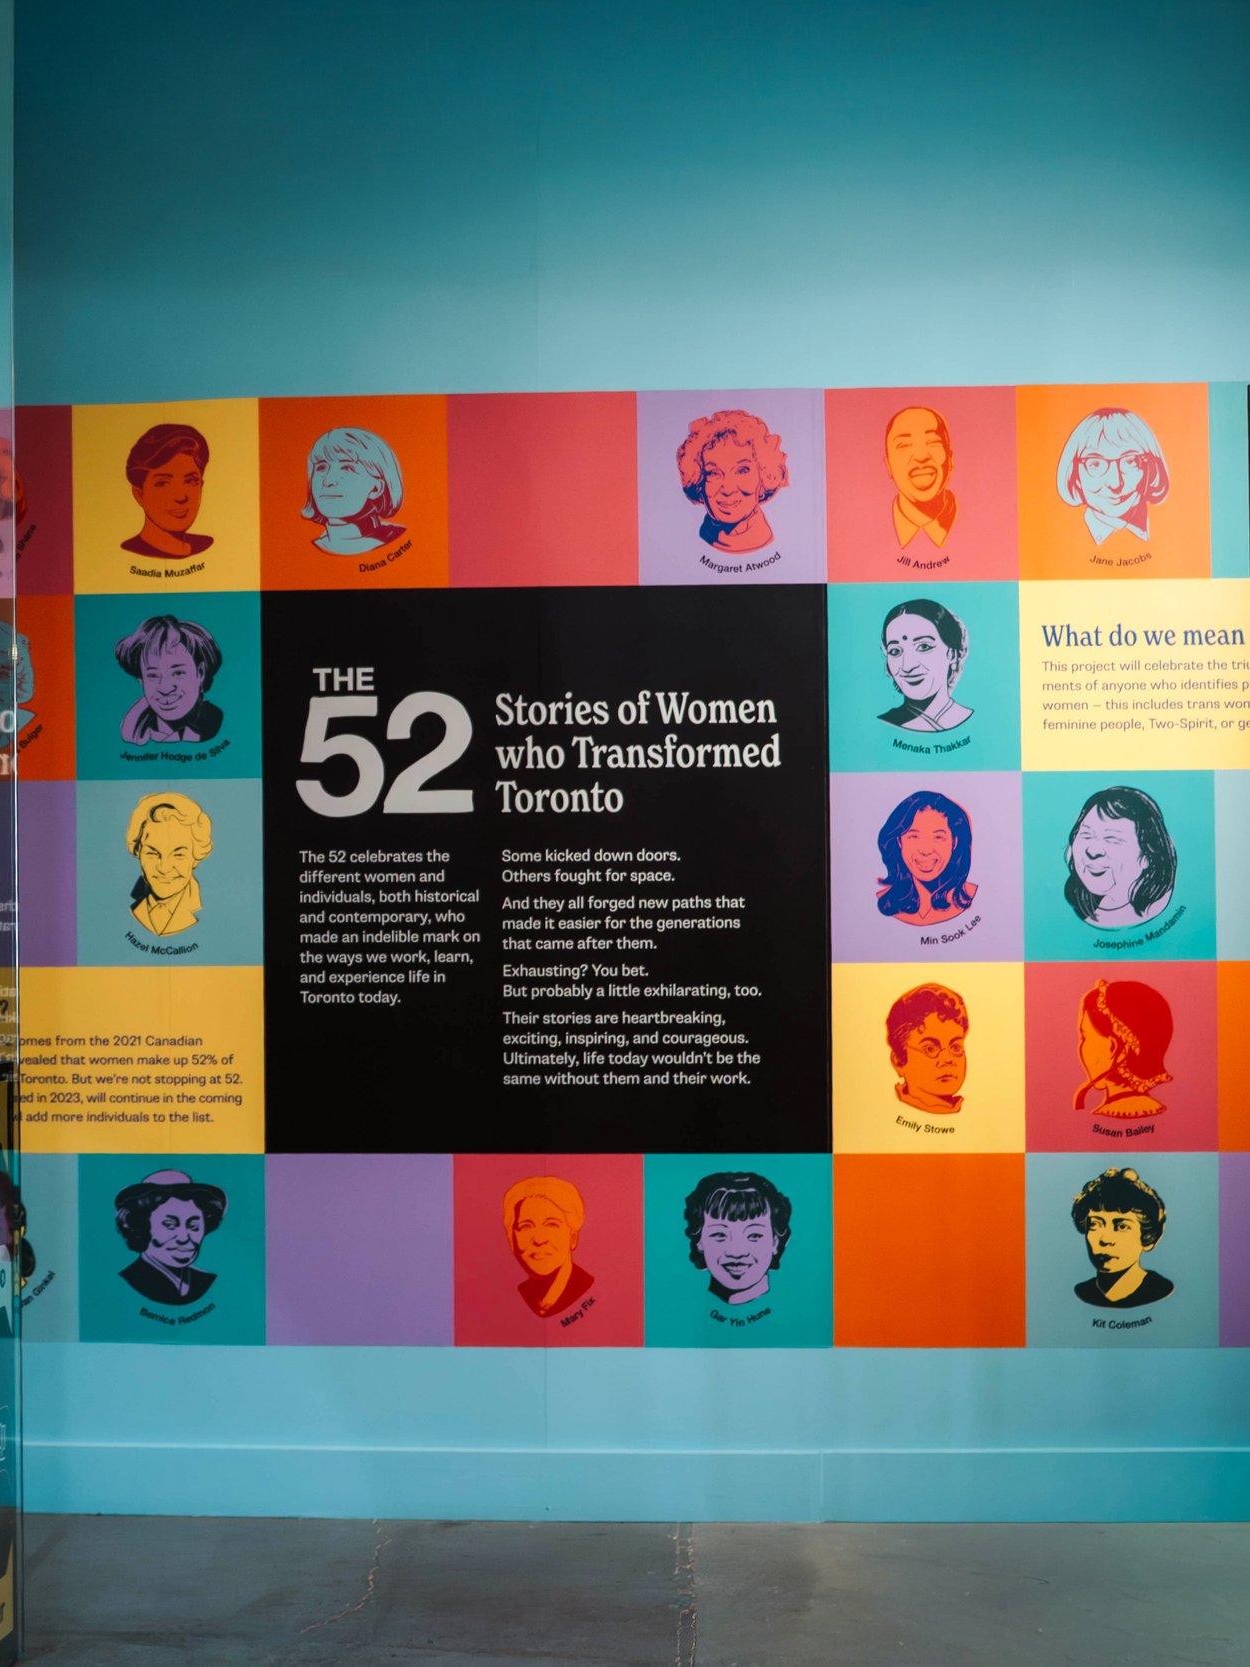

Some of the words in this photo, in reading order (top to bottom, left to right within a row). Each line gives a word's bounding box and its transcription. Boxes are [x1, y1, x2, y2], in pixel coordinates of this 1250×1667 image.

[358, 558, 387, 573] Diana
[387, 538, 413, 564] Carter
[699, 555, 743, 574] Margaret
[745, 551, 781, 573] Atwood
[896, 555, 911, 567] Jill
[913, 554, 950, 570] Andrew
[1089, 555, 1114, 567] Jane
[1116, 552, 1152, 567] Jacobs
[129, 564, 162, 578] Saadia
[164, 560, 207, 578] Muzaffar
[1040, 623, 1104, 648] What
[1108, 622, 1138, 647] do
[1142, 629, 1177, 647] we
[1182, 628, 1246, 647] mean
[1041, 660, 1068, 672] This
[1071, 660, 1116, 674] project
[1119, 659, 1141, 672] will
[1144, 659, 1204, 672] celebrate
[1207, 658, 1228, 671] the
[313, 667, 375, 692] THE
[1041, 681, 1082, 692] ments
[1084, 679, 1099, 692] of
[1101, 681, 1147, 694] anyone
[1150, 678, 1178, 691] who
[1180, 678, 1239, 690] identifies
[495, 691, 610, 726] Stories
[617, 690, 651, 725] of
[655, 691, 778, 726] Women
[494, 735, 566, 770] who
[571, 732, 782, 769] Transformed
[892, 738, 931, 754] Menaka
[933, 735, 971, 754] Thakkar
[295, 691, 474, 818] 52
[494, 780, 624, 814] Toronto
[298, 850, 326, 864] The
[328, 849, 347, 864] 52
[349, 849, 424, 864] celebrates
[426, 849, 450, 863] the
[501, 849, 542, 863] Some
[545, 848, 591, 863] kicked
[593, 848, 634, 862] down
[636, 848, 681, 862] doors.
[299, 869, 361, 884] different
[363, 872, 416, 883] women
[419, 868, 445, 883] and
[501, 869, 552, 883] Others
[553, 868, 602, 885] fought
[604, 868, 628, 882] for
[629, 871, 676, 885] space.
[299, 889, 376, 904] individuals,
[379, 889, 411, 903] both
[414, 888, 480, 903] historical
[501, 896, 530, 910] And
[532, 896, 565, 913] they
[567, 895, 585, 910] all
[587, 895, 635, 913] forged
[638, 898, 669, 909] new
[671, 895, 712, 912] paths
[714, 894, 746, 909] that
[299, 911, 326, 924] and
[328, 911, 432, 926] contemporary,
[434, 909, 466, 923] who
[502, 916, 542, 930] made
[544, 916, 556, 930] it
[558, 916, 602, 930] easier
[604, 915, 627, 930] for
[629, 915, 654, 930] the
[656, 915, 741, 933] generations
[920, 936, 938, 946] Min
[941, 929, 966, 945] Sook
[965, 914, 982, 932] Lee
[1092, 937, 1145, 951] Josephine
[1144, 904, 1187, 943] Mandamin
[124, 930, 149, 952] Hazel
[150, 942, 199, 955] McCallion
[299, 930, 339, 944] made
[341, 933, 359, 944] an
[362, 929, 420, 943] indelible
[422, 929, 460, 943] mark
[462, 932, 481, 943] on
[501, 936, 532, 950] that
[535, 939, 575, 950] came
[576, 935, 614, 950] after
[615, 935, 658, 950] them.
[299, 950, 323, 964] the
[326, 953, 363, 966] ways
[365, 953, 388, 964] we
[390, 949, 431, 965] work,
[434, 949, 474, 965] learn,
[299, 970, 326, 984] and
[328, 970, 405, 984] experience
[408, 969, 431, 983] life
[433, 970, 446, 983] in
[299, 990, 356, 1004] Toronto
[357, 990, 401, 1007] today.
[55, 1034, 86, 1047] from
[89, 1035, 110, 1047] the
[112, 1034, 142, 1047] 2021
[145, 1035, 203, 1047] Canadian
[60, 1054, 86, 1066] that
[88, 1056, 134, 1066] women
[136, 1054, 171, 1066] make
[173, 1057, 189, 1066] up
[191, 1053, 218, 1066] 52%
[220, 1053, 235, 1066] of
[895, 1115, 922, 1132] Emily
[924, 1124, 955, 1134] Stowe
[1092, 1124, 1122, 1138] Susan
[1125, 1123, 1155, 1138] Bailey
[560, 1309, 584, 1329] Mary
[582, 1296, 596, 1312] Fix
[709, 1309, 727, 1324] Gar
[729, 1315, 746, 1328] Yin
[746, 1305, 772, 1325] Hune
[1092, 1318, 1106, 1329] Kit
[1108, 1315, 1153, 1330] Coleman
